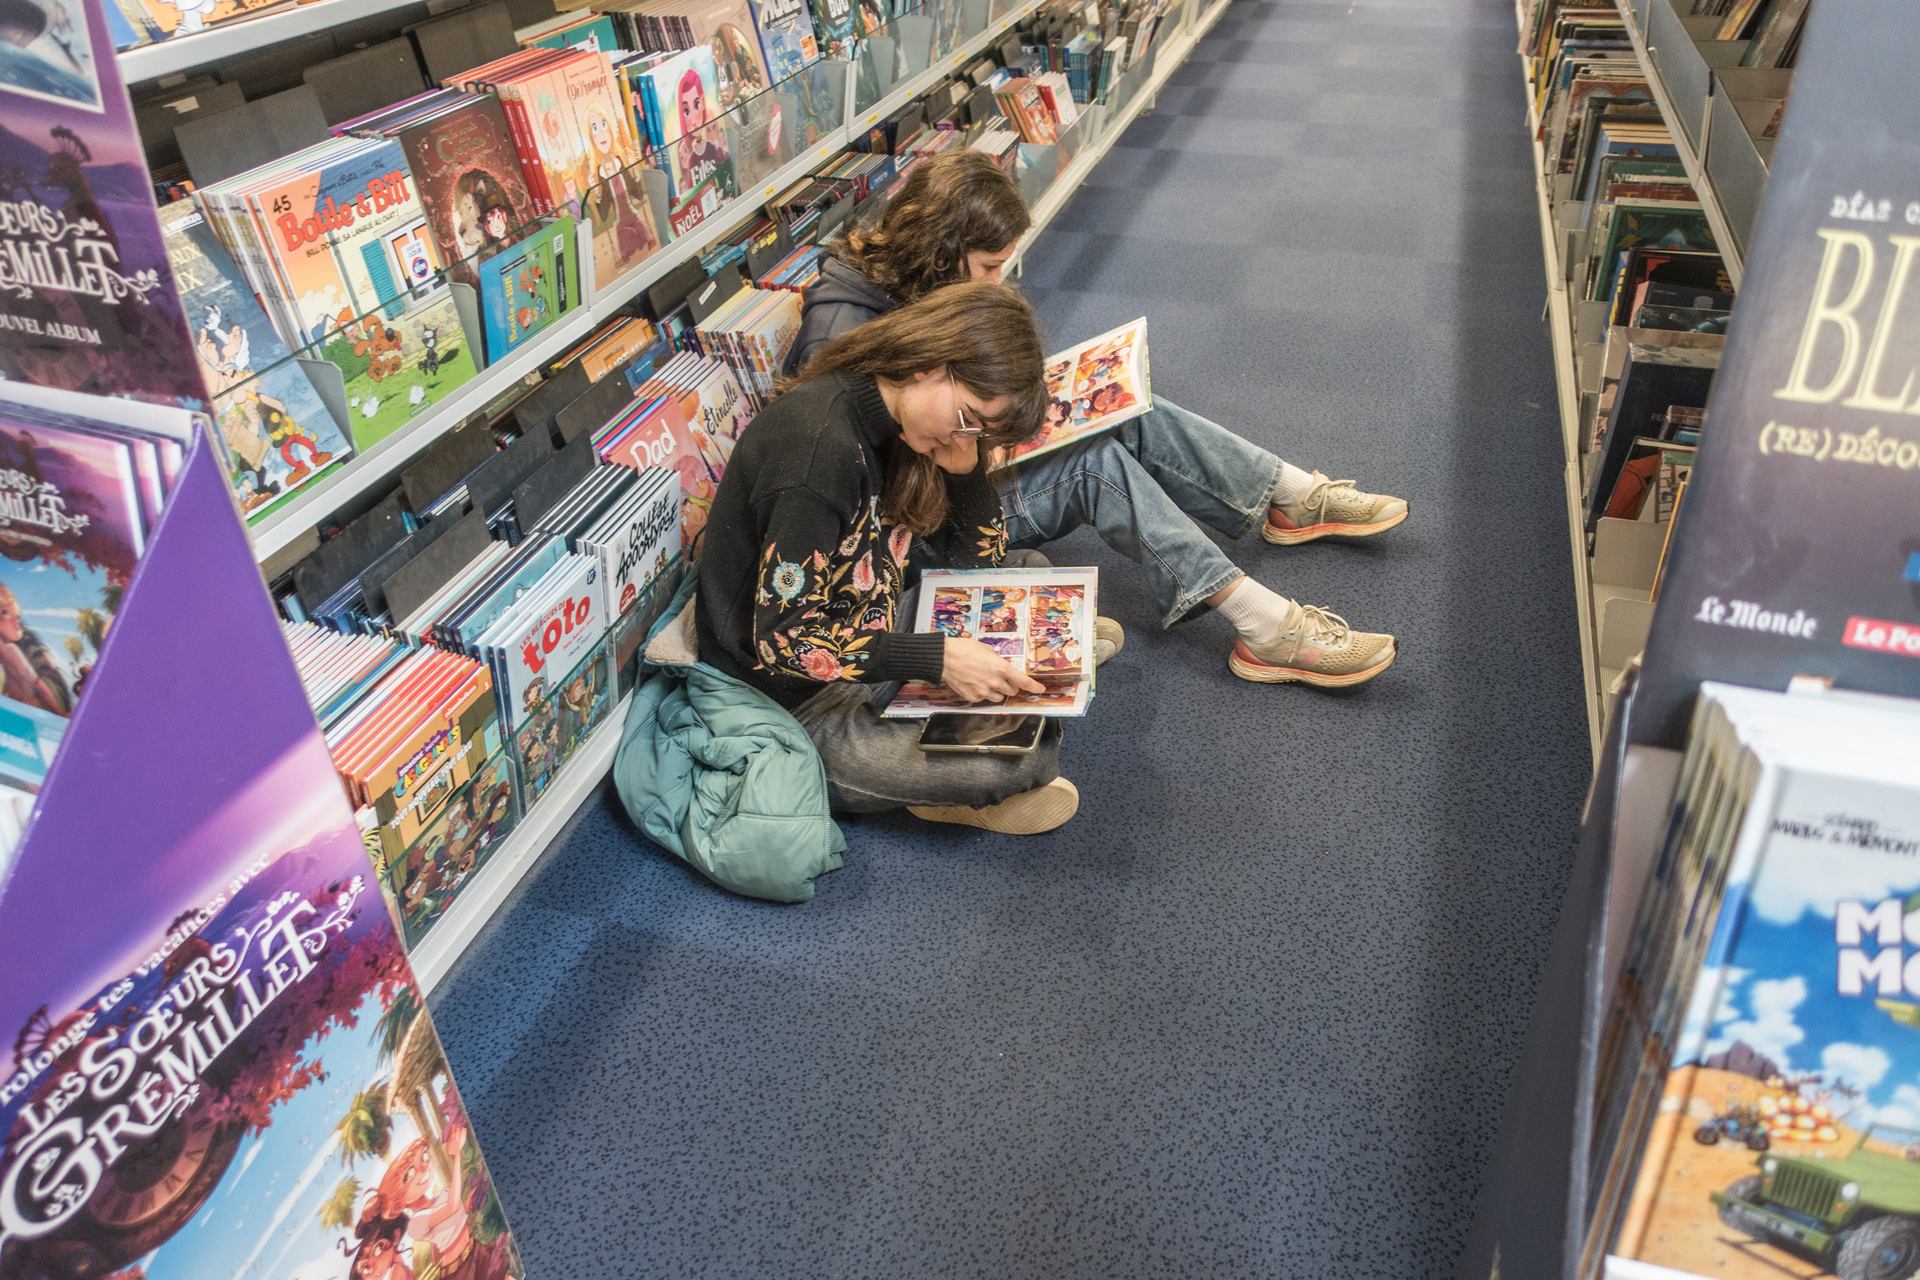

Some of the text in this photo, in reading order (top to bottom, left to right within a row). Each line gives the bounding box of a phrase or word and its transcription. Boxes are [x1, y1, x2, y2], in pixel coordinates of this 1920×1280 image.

[272, 195, 292, 214] 45
[276, 195, 355, 252] Boule
[356, 192, 372, 218] &
[367, 169, 410, 214] Bill
[674, 204, 702, 236] NOËL
[1830, 190, 1892, 222] DÍAZ
[46, 323, 102, 345] ALBUM
[1772, 227, 1920, 414] BL
[630, 418, 677, 473] Dad
[1758, 419, 1920, 471] (RE)DÉCO
[615, 497, 679, 588] APOCALYPSE
[522, 595, 591, 674] toto
[1694, 596, 1818, 639] Le Monde
[1853, 619, 1886, 645] Le
[97, 978, 135, 1012] tes
[134, 893, 227, 977] vacances
[229, 853, 269, 895] avec
[1835, 897, 1920, 946] M
[1837, 947, 1920, 997] M
[17, 1071, 88, 1139] LES
